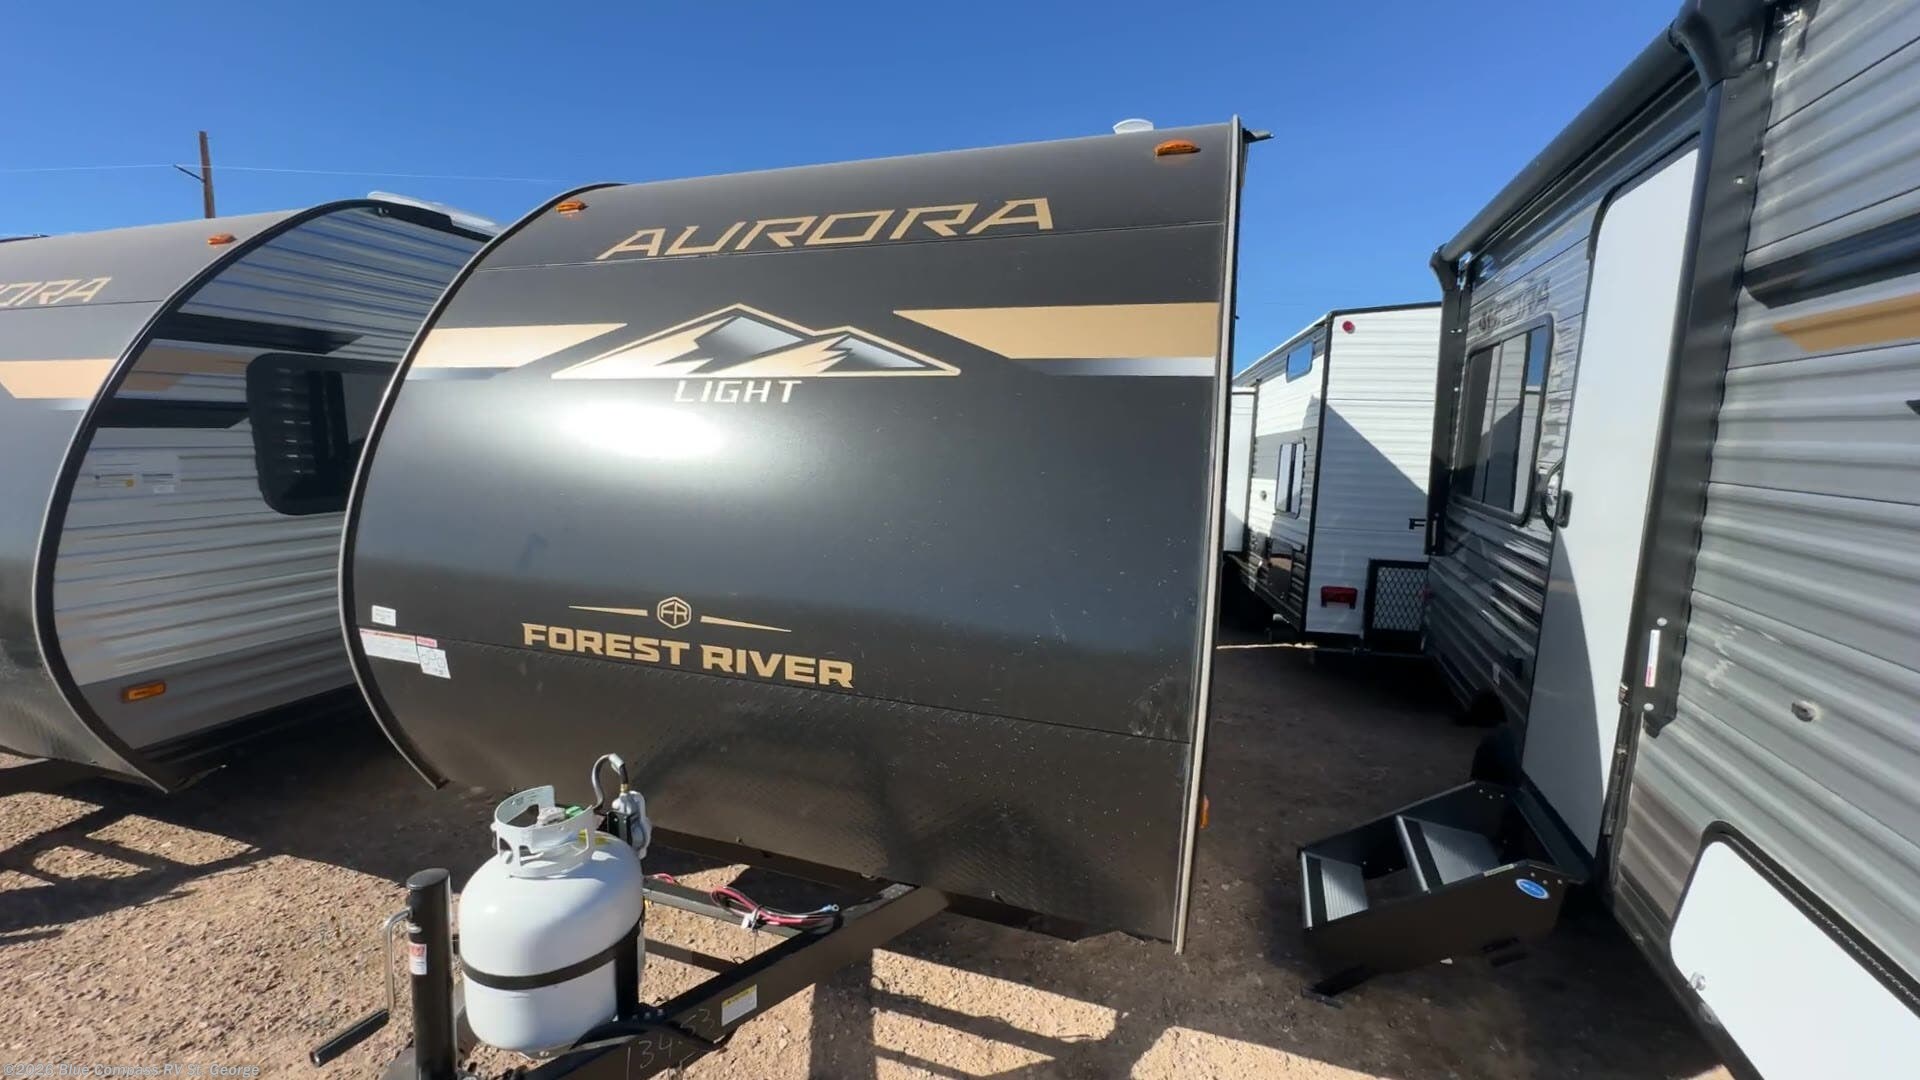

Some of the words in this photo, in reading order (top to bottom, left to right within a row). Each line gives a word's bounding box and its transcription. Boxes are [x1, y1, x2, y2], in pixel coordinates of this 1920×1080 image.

[596, 198, 1053, 260] AURORA
[0, 276, 112, 305] ORA
[675, 380, 801, 403] LIGHT
[522, 623, 690, 666] FOREST
[700, 645, 854, 688] RIVER
